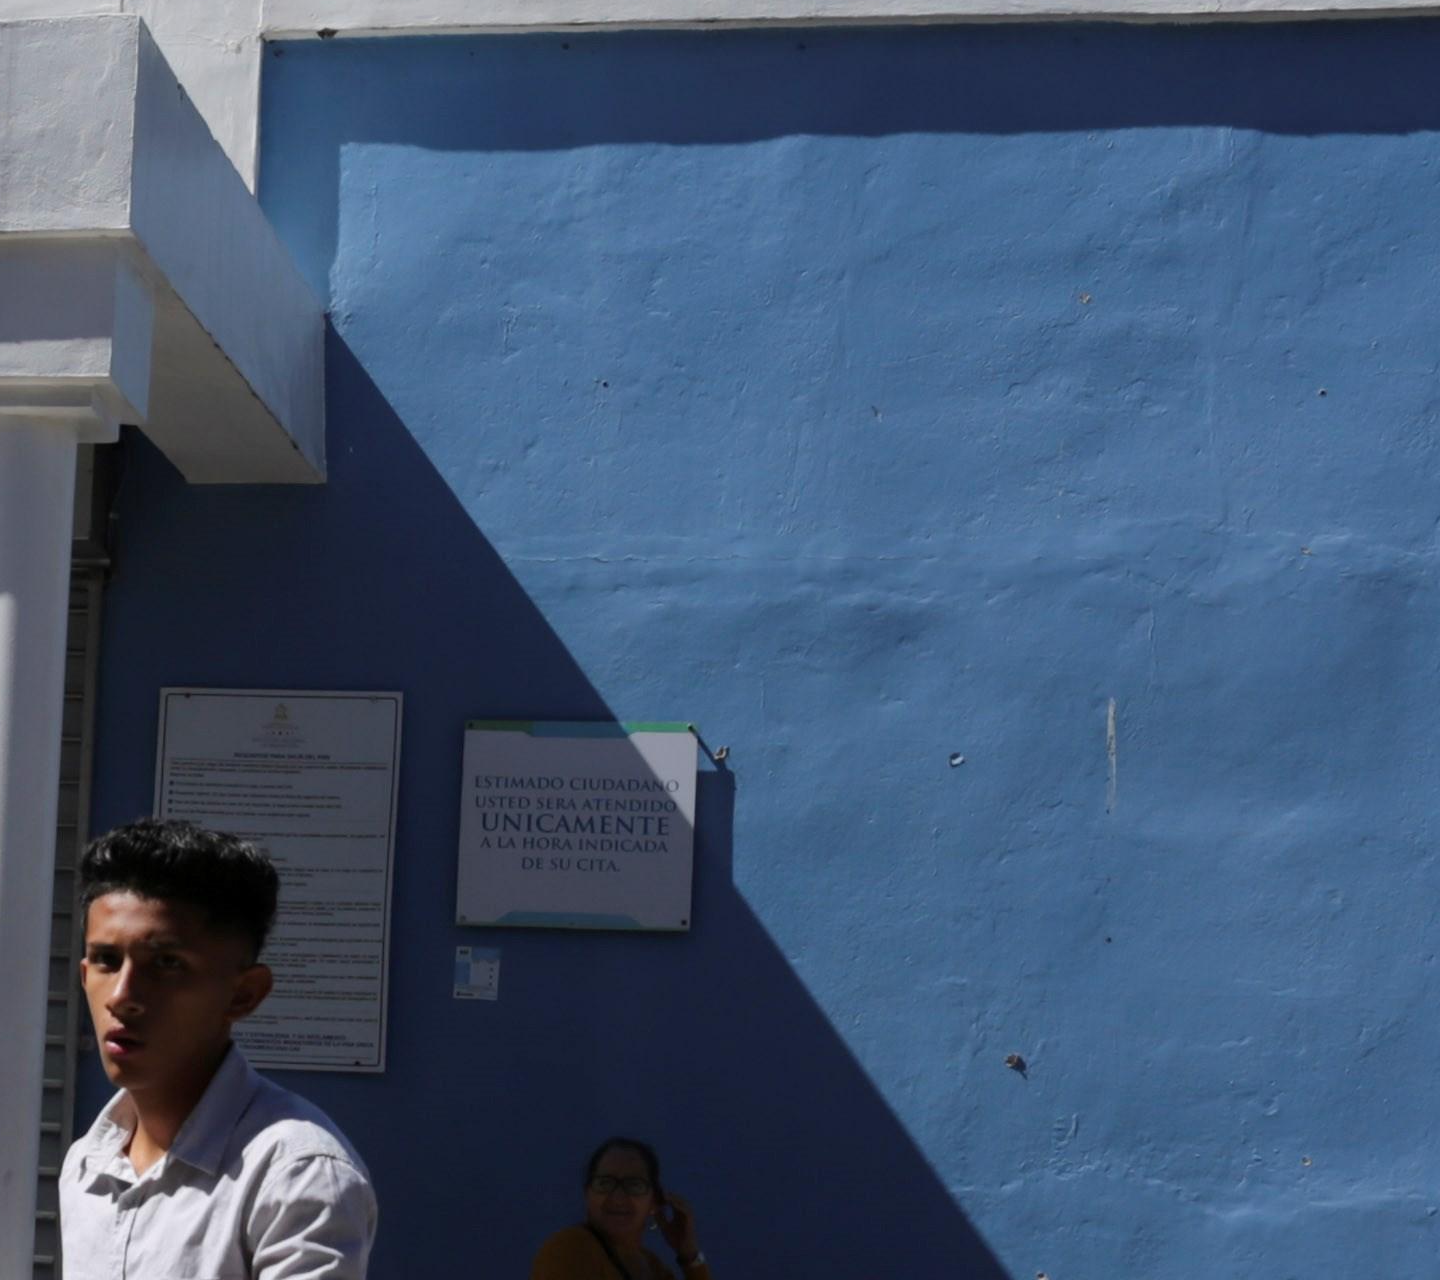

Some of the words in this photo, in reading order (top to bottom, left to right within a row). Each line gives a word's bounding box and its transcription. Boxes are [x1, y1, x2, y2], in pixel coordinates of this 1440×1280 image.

[474, 775, 564, 791] ESTIMADO
[569, 777, 680, 793] CIUDADANO
[475, 795, 531, 810] USTED
[536, 797, 576, 811] SERA
[581, 797, 677, 814] ATENDIDO
[481, 812, 670, 837] UNICAMENTE
[480, 836, 491, 849] A
[497, 836, 516, 849] LA
[522, 837, 573, 851] HORA
[578, 838, 669, 853] INDICADA
[521, 856, 545, 870] DE
[551, 857, 570, 871] SU
